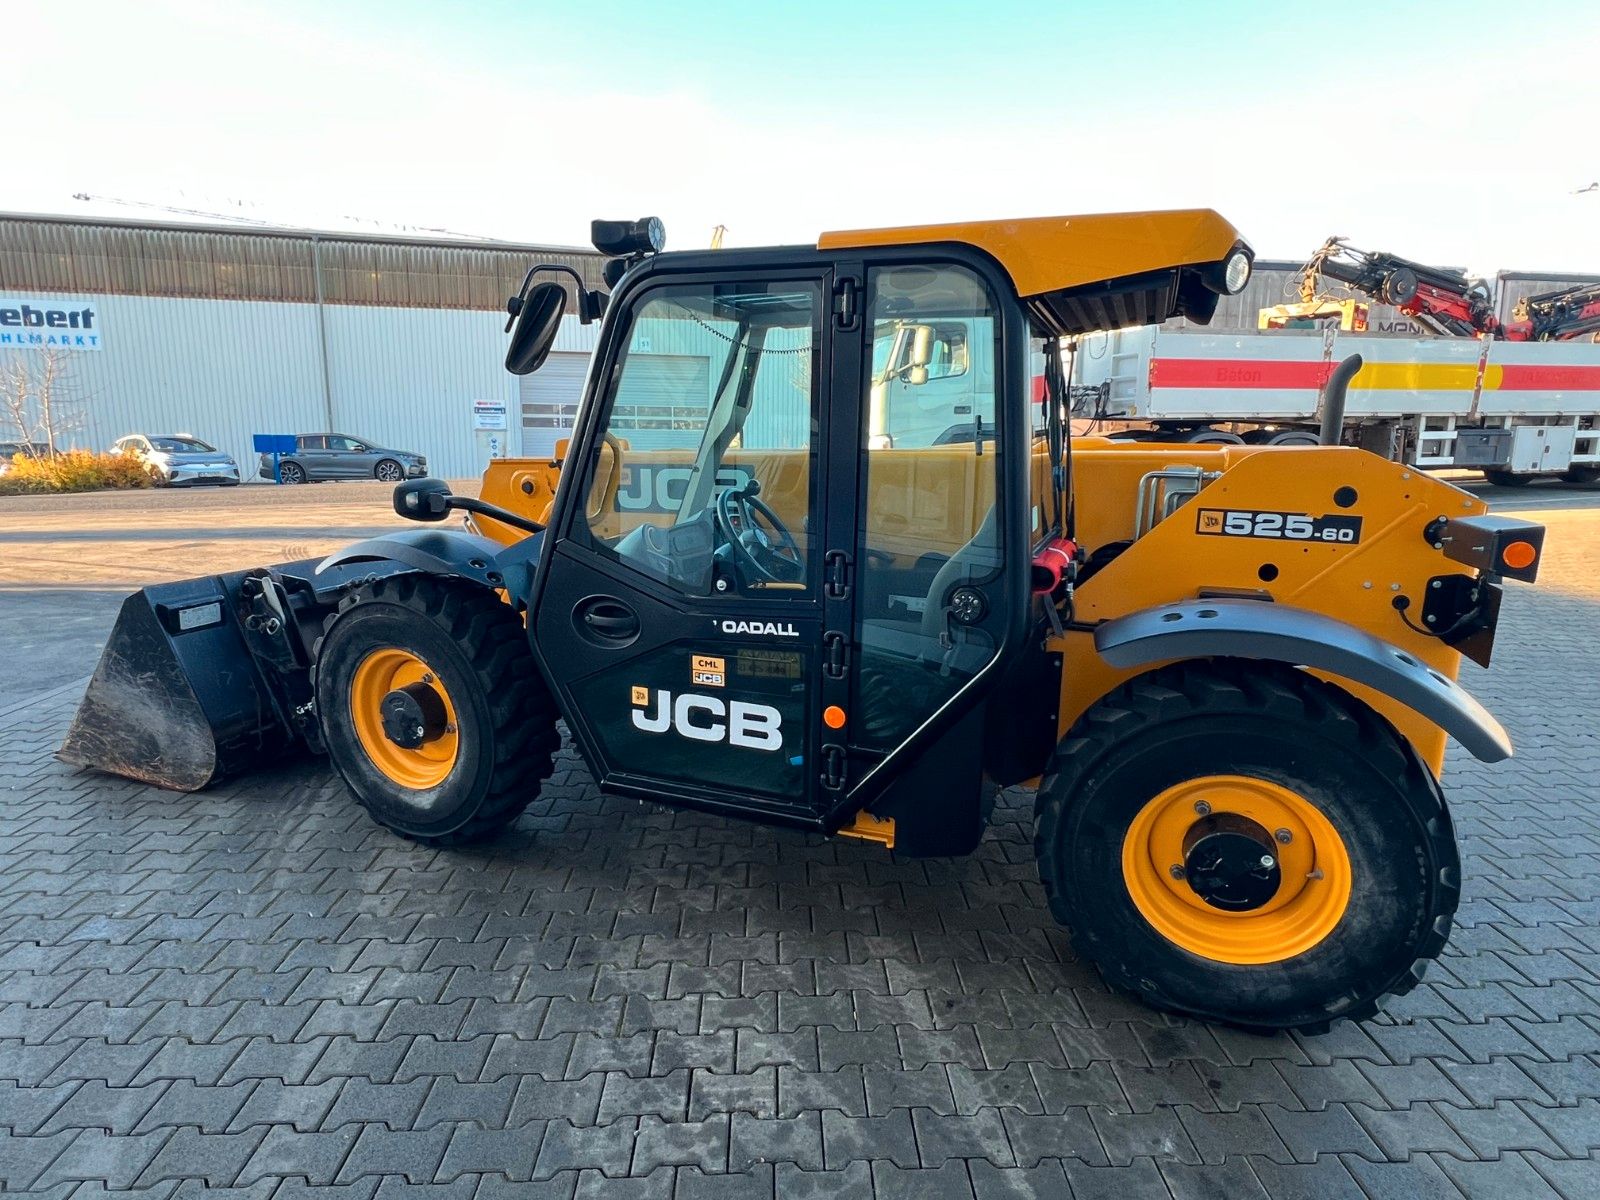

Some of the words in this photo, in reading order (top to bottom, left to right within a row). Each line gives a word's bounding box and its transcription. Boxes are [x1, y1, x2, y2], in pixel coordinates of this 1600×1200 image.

[0, 333, 98, 345] HLMARKT
[713, 620, 800, 637] OADALL
[698, 659, 719, 669] CML
[694, 671, 723, 684] JCB
[631, 689, 784, 751] JCB
